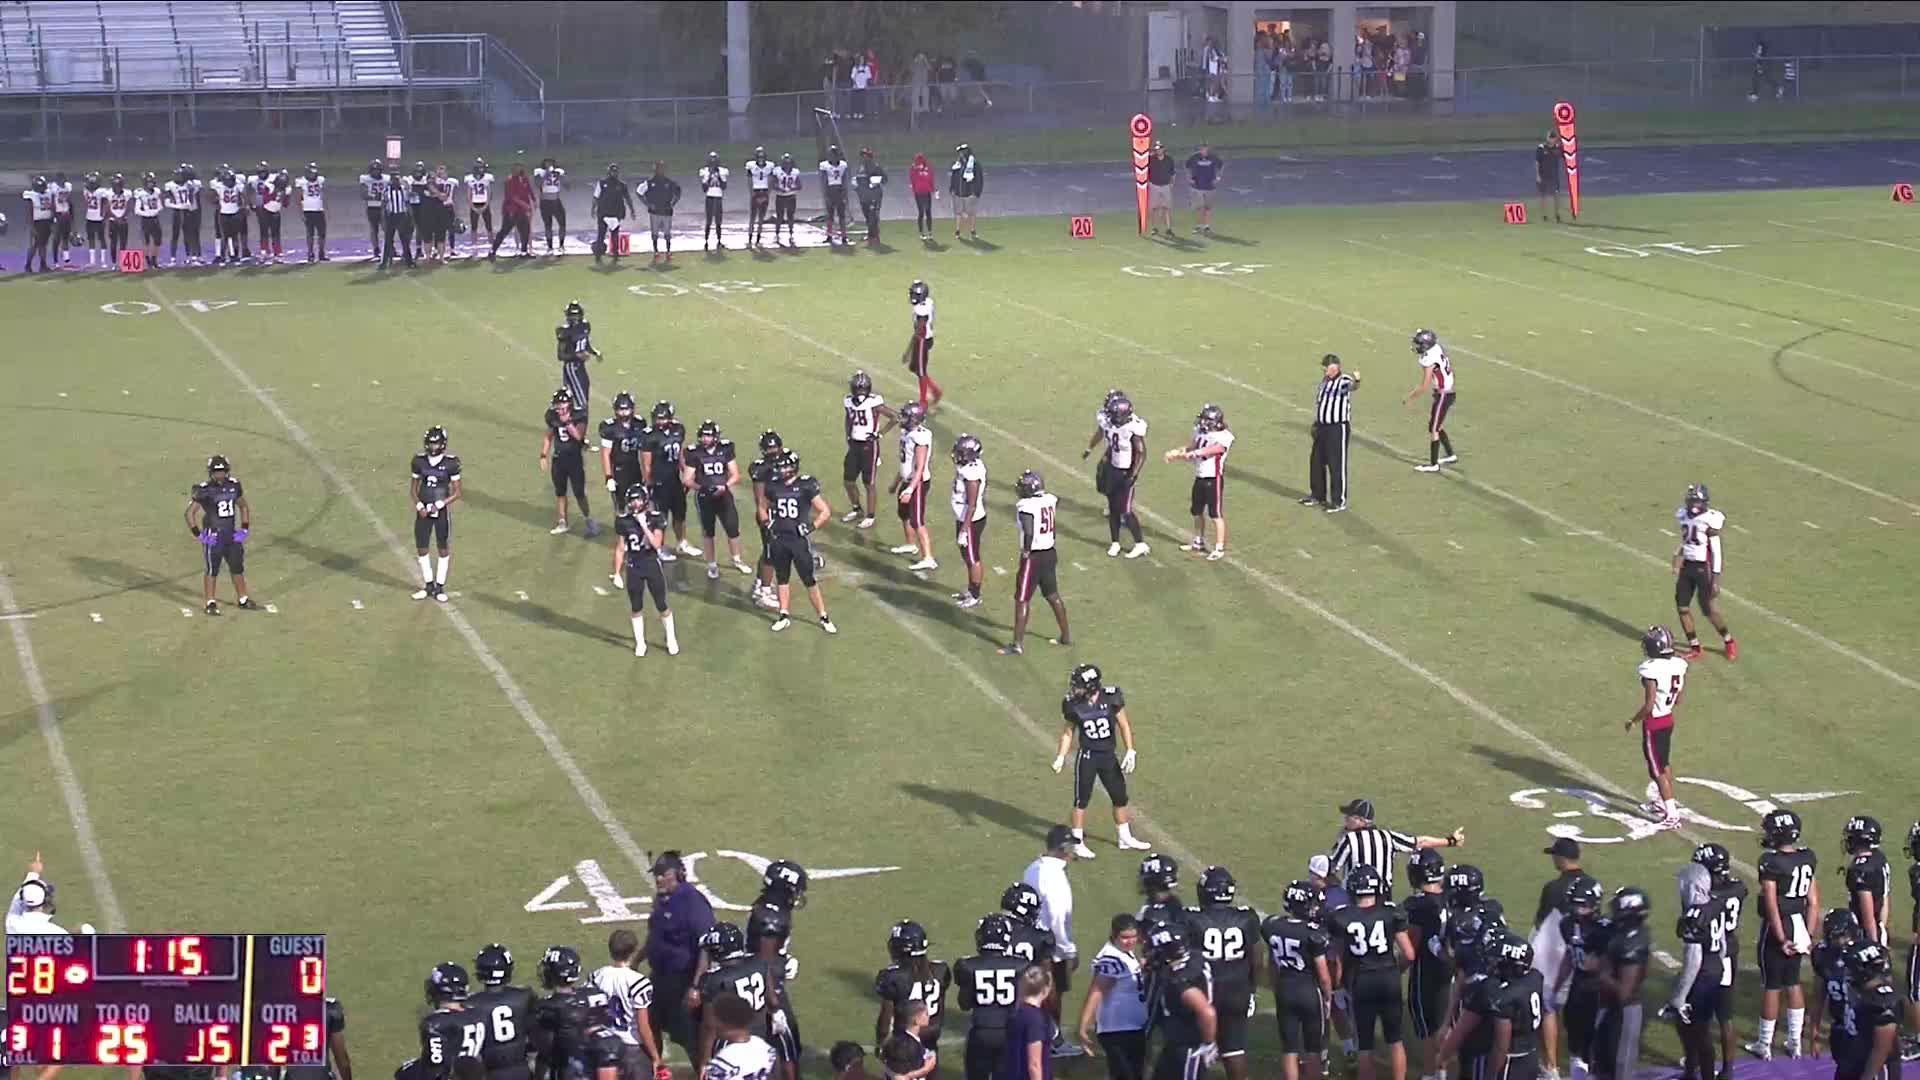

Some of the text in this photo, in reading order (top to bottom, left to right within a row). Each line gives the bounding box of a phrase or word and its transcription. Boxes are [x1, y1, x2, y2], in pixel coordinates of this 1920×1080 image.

[307, 184, 320, 197] 55
[1900, 184, 1913, 201] G
[1507, 206, 1524, 222] 10
[1074, 218, 1092, 234] 20
[122, 253, 141, 271] 40
[99, 299, 239, 316] 40
[851, 409, 869, 427] 28
[217, 500, 235, 518] 21
[777, 498, 799, 519] 56
[1665, 674, 1680, 706] 5
[1083, 717, 1111, 739] 22
[524, 849, 773, 923] 40
[1450, 873, 1469, 887] PR
[1785, 863, 1814, 898] 16
[1201, 926, 1245, 961] 92
[1346, 920, 1389, 956] 34
[1269, 935, 1306, 971] 25
[1501, 943, 1523, 960] PR
[735, 971, 766, 1010] 52
[908, 978, 941, 1017] 42
[974, 968, 1016, 1006] 55
[1530, 991, 1542, 1030] 9
[491, 1005, 516, 1043] 6
